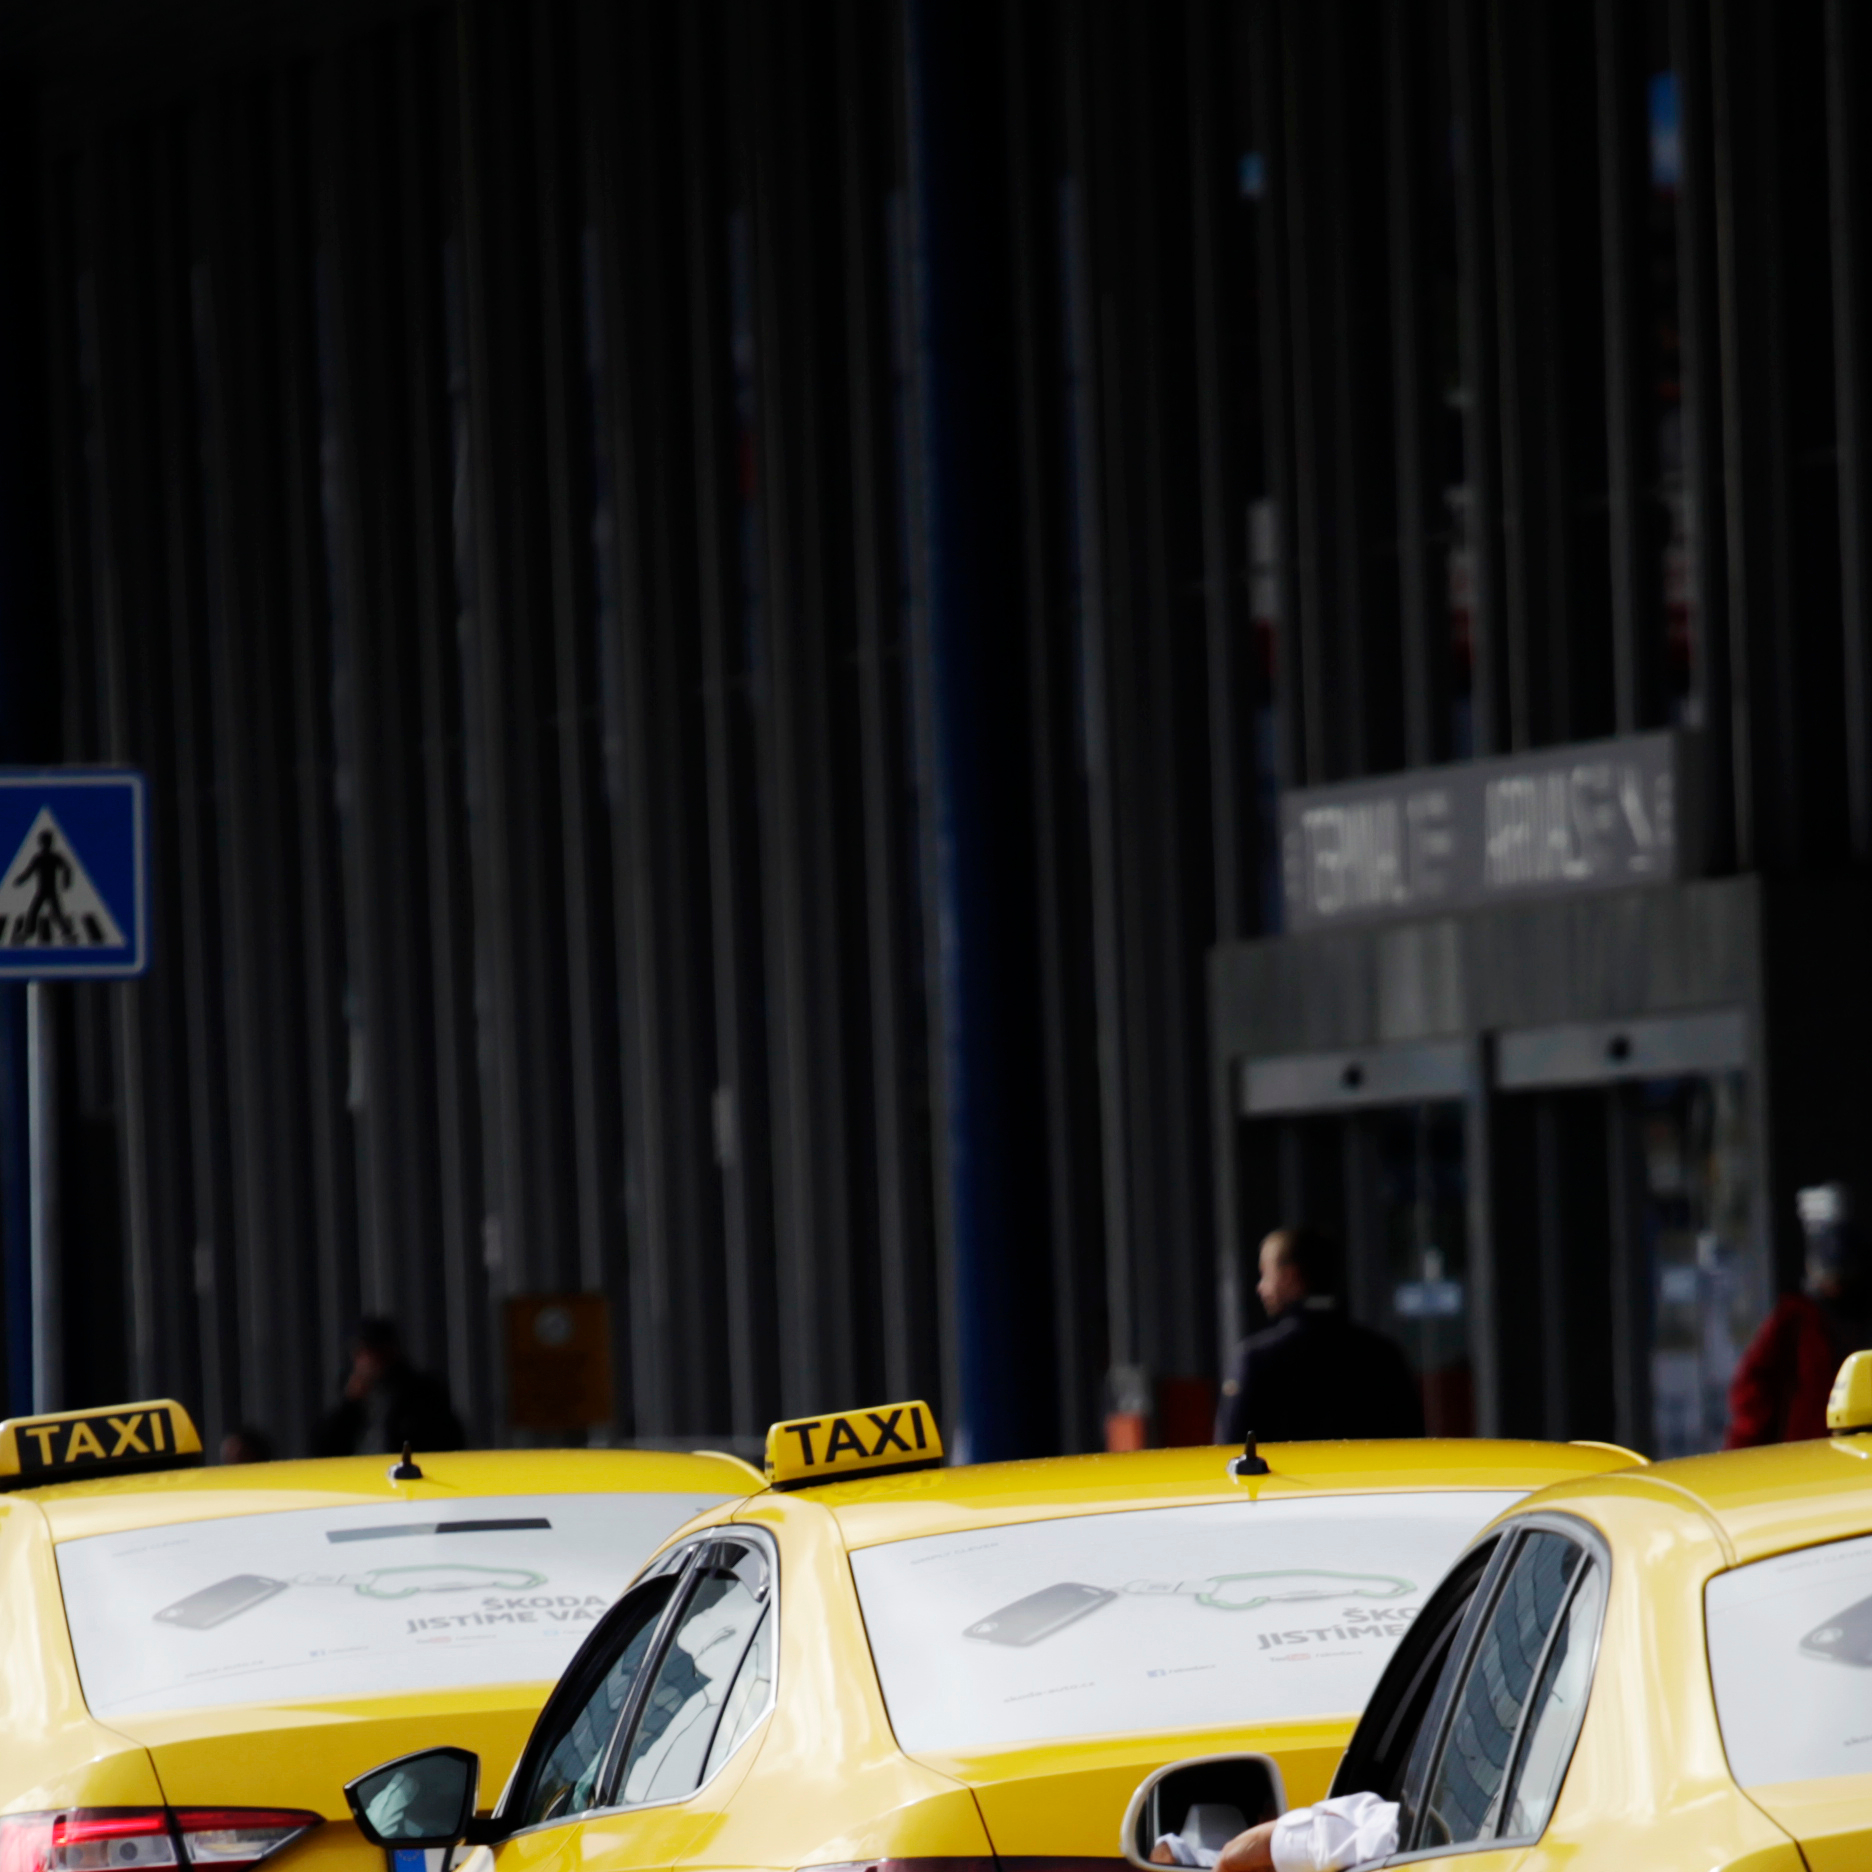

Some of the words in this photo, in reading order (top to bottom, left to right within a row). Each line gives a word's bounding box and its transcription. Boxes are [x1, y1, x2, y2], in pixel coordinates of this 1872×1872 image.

[24, 1411, 166, 1467] TAXI
[784, 1406, 927, 1466] TAXI
[482, 1595, 608, 1612] ŠKODA
[1257, 1623, 1404, 1651] JISTÍME
